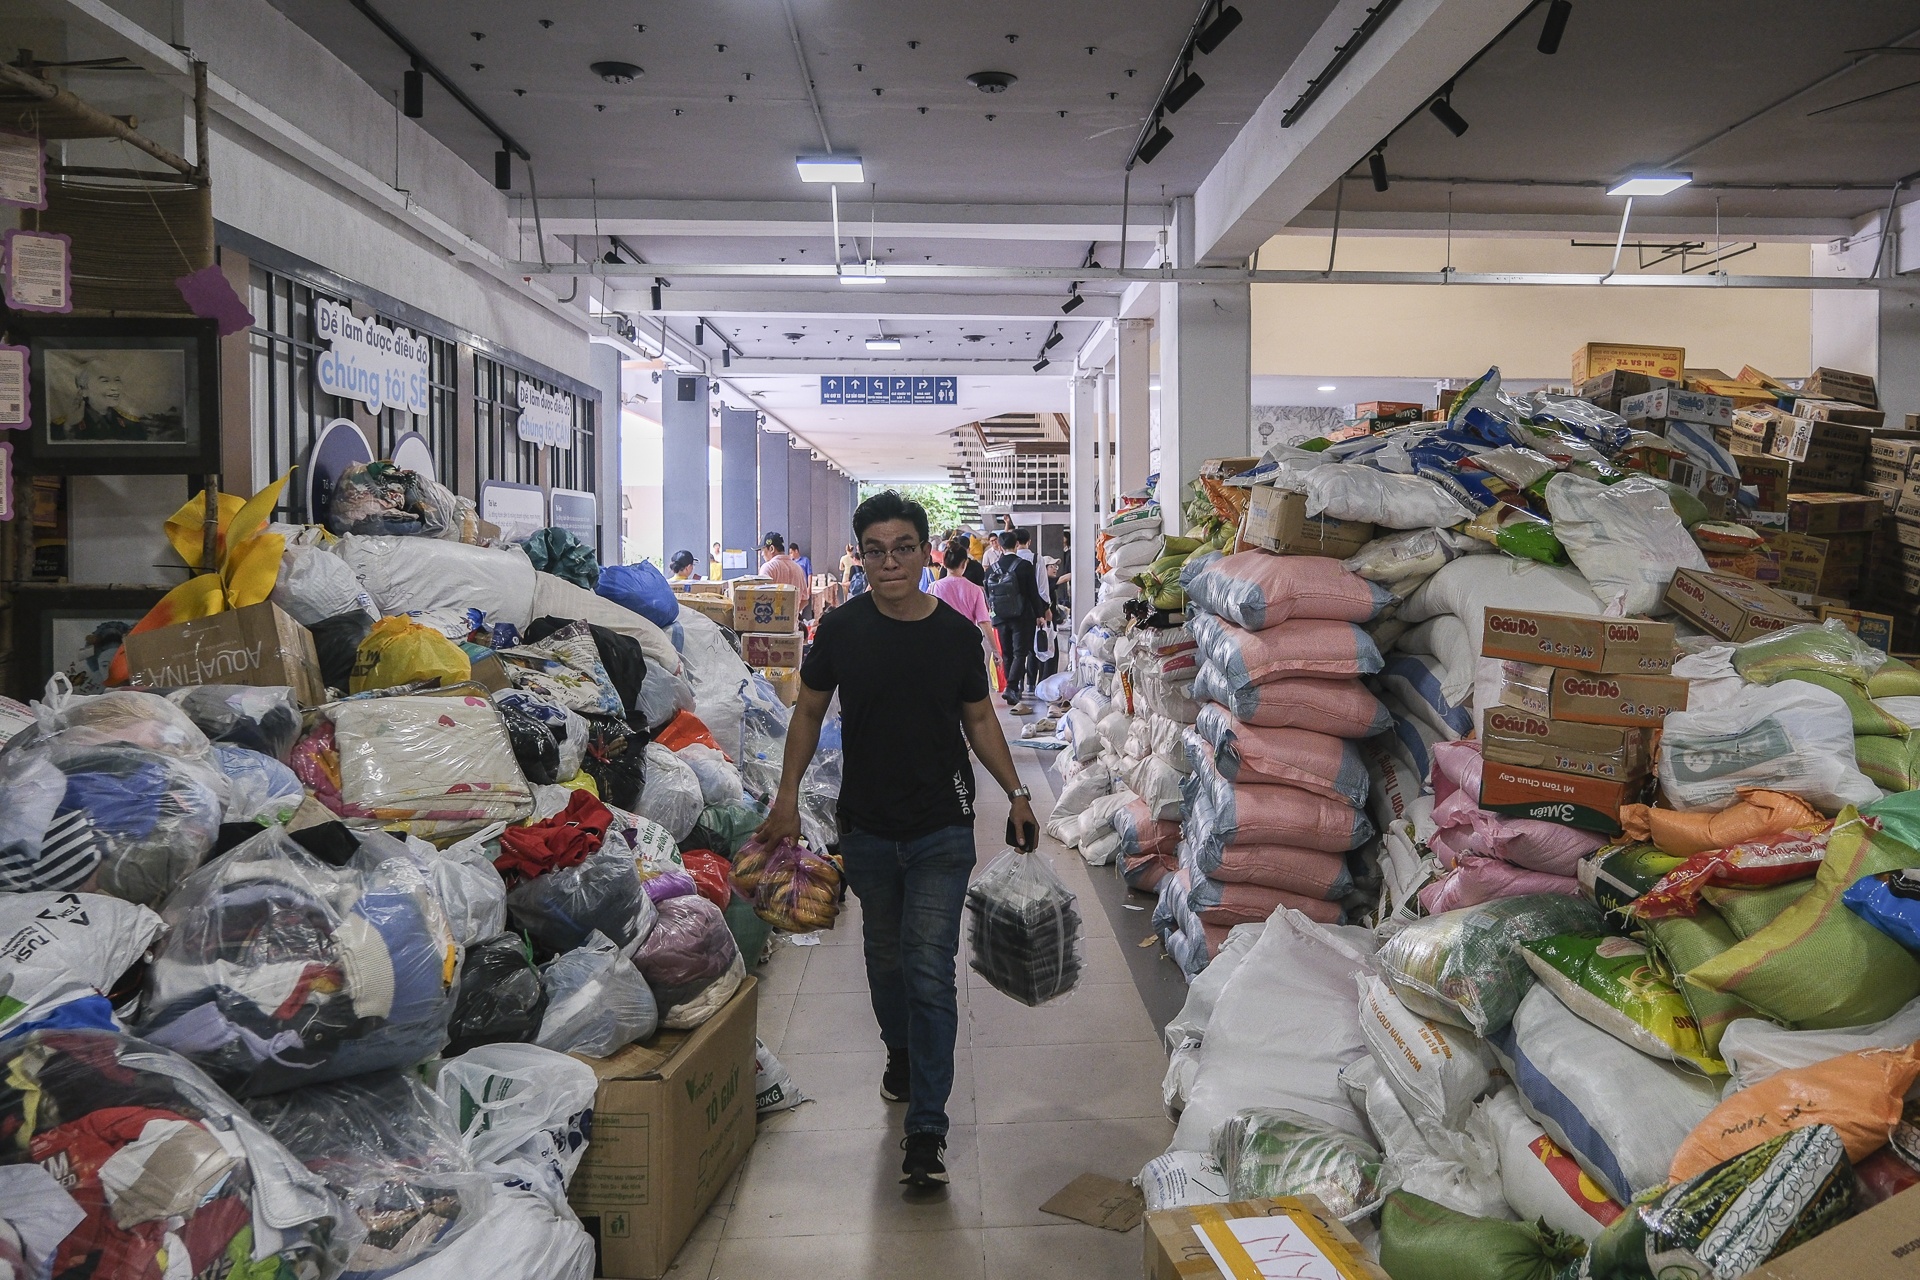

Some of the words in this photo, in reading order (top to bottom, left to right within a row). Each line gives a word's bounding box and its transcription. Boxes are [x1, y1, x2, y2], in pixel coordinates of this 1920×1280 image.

[321, 308, 338, 334] Để
[342, 315, 362, 342] làm
[366, 325, 392, 356] được
[394, 335, 414, 359] điều
[416, 343, 428, 364] đó
[1616, 358, 1629, 367] TẾ
[322, 351, 380, 407] chúng
[385, 368, 406, 402] tôi
[410, 368, 426, 408] SẼ
[520, 414, 543, 444] chúng
[545, 421, 554, 440] tôi
[1538, 640, 1551, 652] Gà
[1556, 642, 1570, 656] Sợi
[1574, 644, 1594, 658] Phở
[148, 641, 262, 688] AQUAFINA
[1619, 703, 1635, 715] Gà
[1638, 704, 1654, 716] Sợi
[1555, 756, 1577, 769] Tôm
[1580, 761, 1594, 772] và
[1598, 763, 1615, 775] Gà
[1499, 772, 1516, 782] Cay
[1517, 779, 1540, 788] Chua
[1542, 780, 1562, 792] Tôm
[1376, 1011, 1392, 1030] GOLD
[1388, 1028, 1406, 1050] NÀNG
[1403, 1046, 1422, 1072] THƠM
